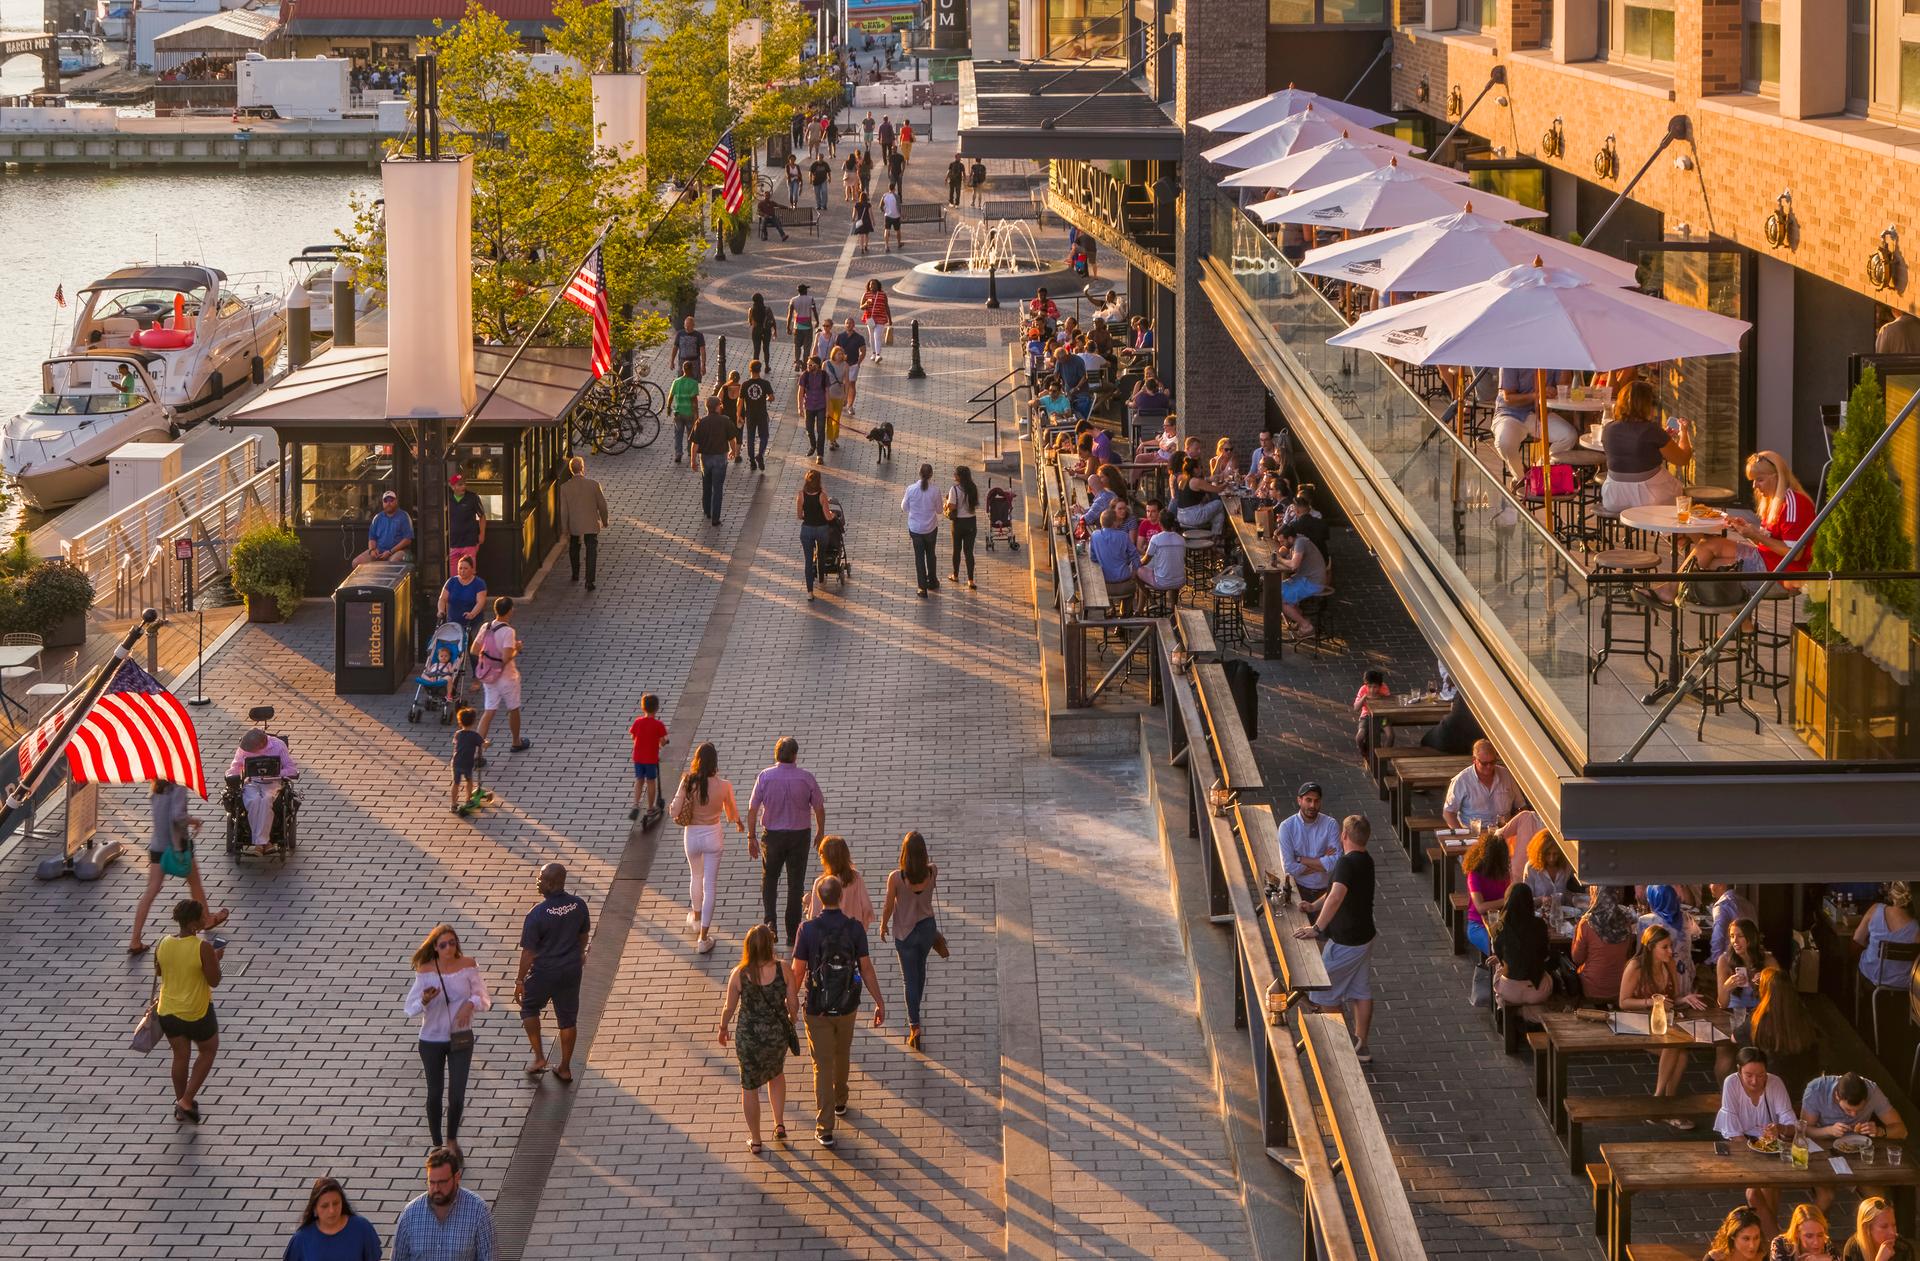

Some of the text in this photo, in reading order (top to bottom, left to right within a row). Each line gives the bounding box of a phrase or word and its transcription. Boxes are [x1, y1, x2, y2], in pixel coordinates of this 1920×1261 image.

[6, 37, 50, 54] MARKET PIER
[1389, 331, 1406, 339] PORT
[368, 602, 384, 666] pitches in
